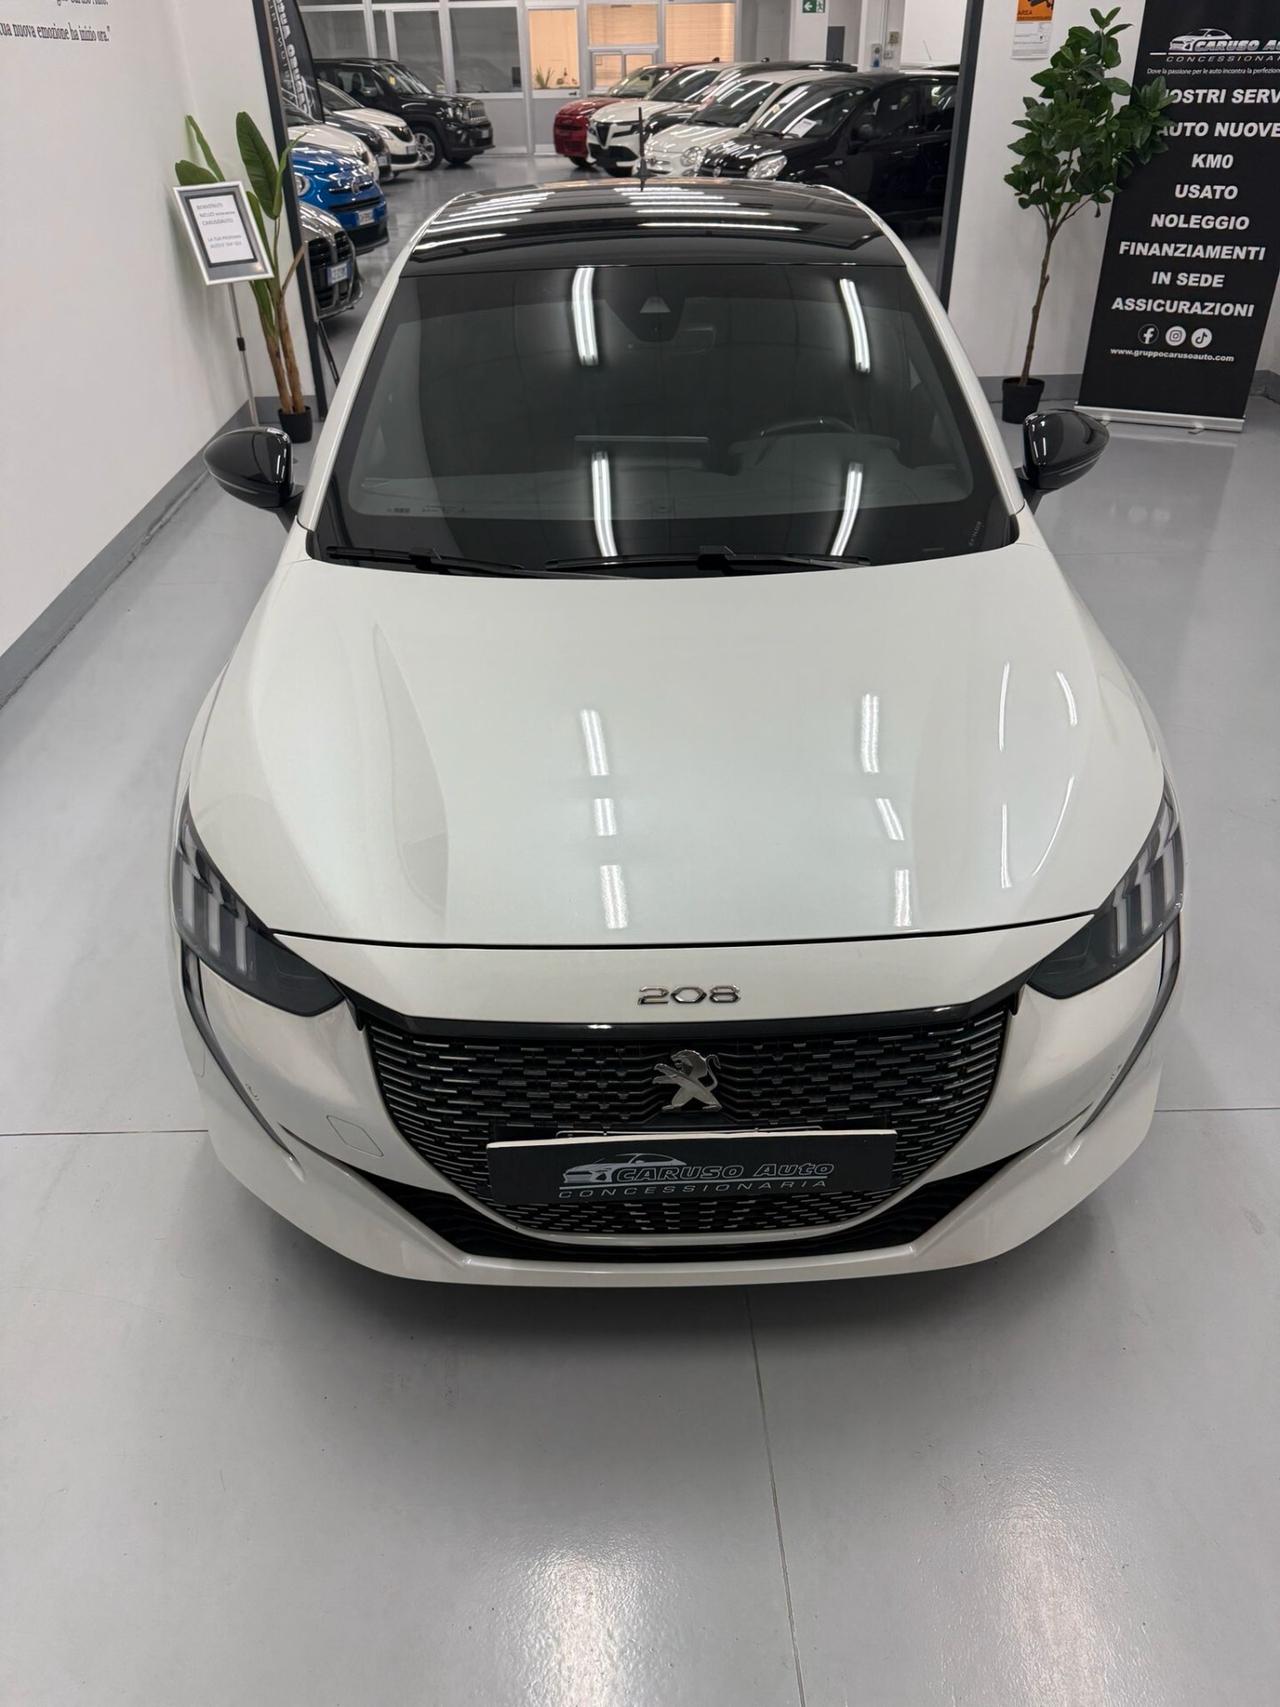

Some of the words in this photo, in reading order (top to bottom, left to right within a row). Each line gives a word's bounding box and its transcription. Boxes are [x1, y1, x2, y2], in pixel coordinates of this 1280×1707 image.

[0, 22, 12, 37] ua
[37, 23, 70, 40] emozione
[1194, 40, 1260, 51] CARUSO
[1165, 88, 1226, 104] OSTRI
[1214, 122, 1280, 138] NUOVE
[1174, 184, 1239, 200] USATO
[1150, 213, 1250, 230] NOLEGGIO
[1119, 241, 1266, 261] FINANZIAMENTI
[1151, 271, 1172, 285] IN
[1176, 272, 1225, 288] SEDE
[1111, 297, 1255, 318] ASSICURAZIONI
[1110, 348, 1234, 362] www.gruppocarusoauto.com
[638, 984, 741, 1005] 208
[616, 1165, 745, 1183] CARUSO
[558, 1180, 828, 1199] CONCESSIONARIA
